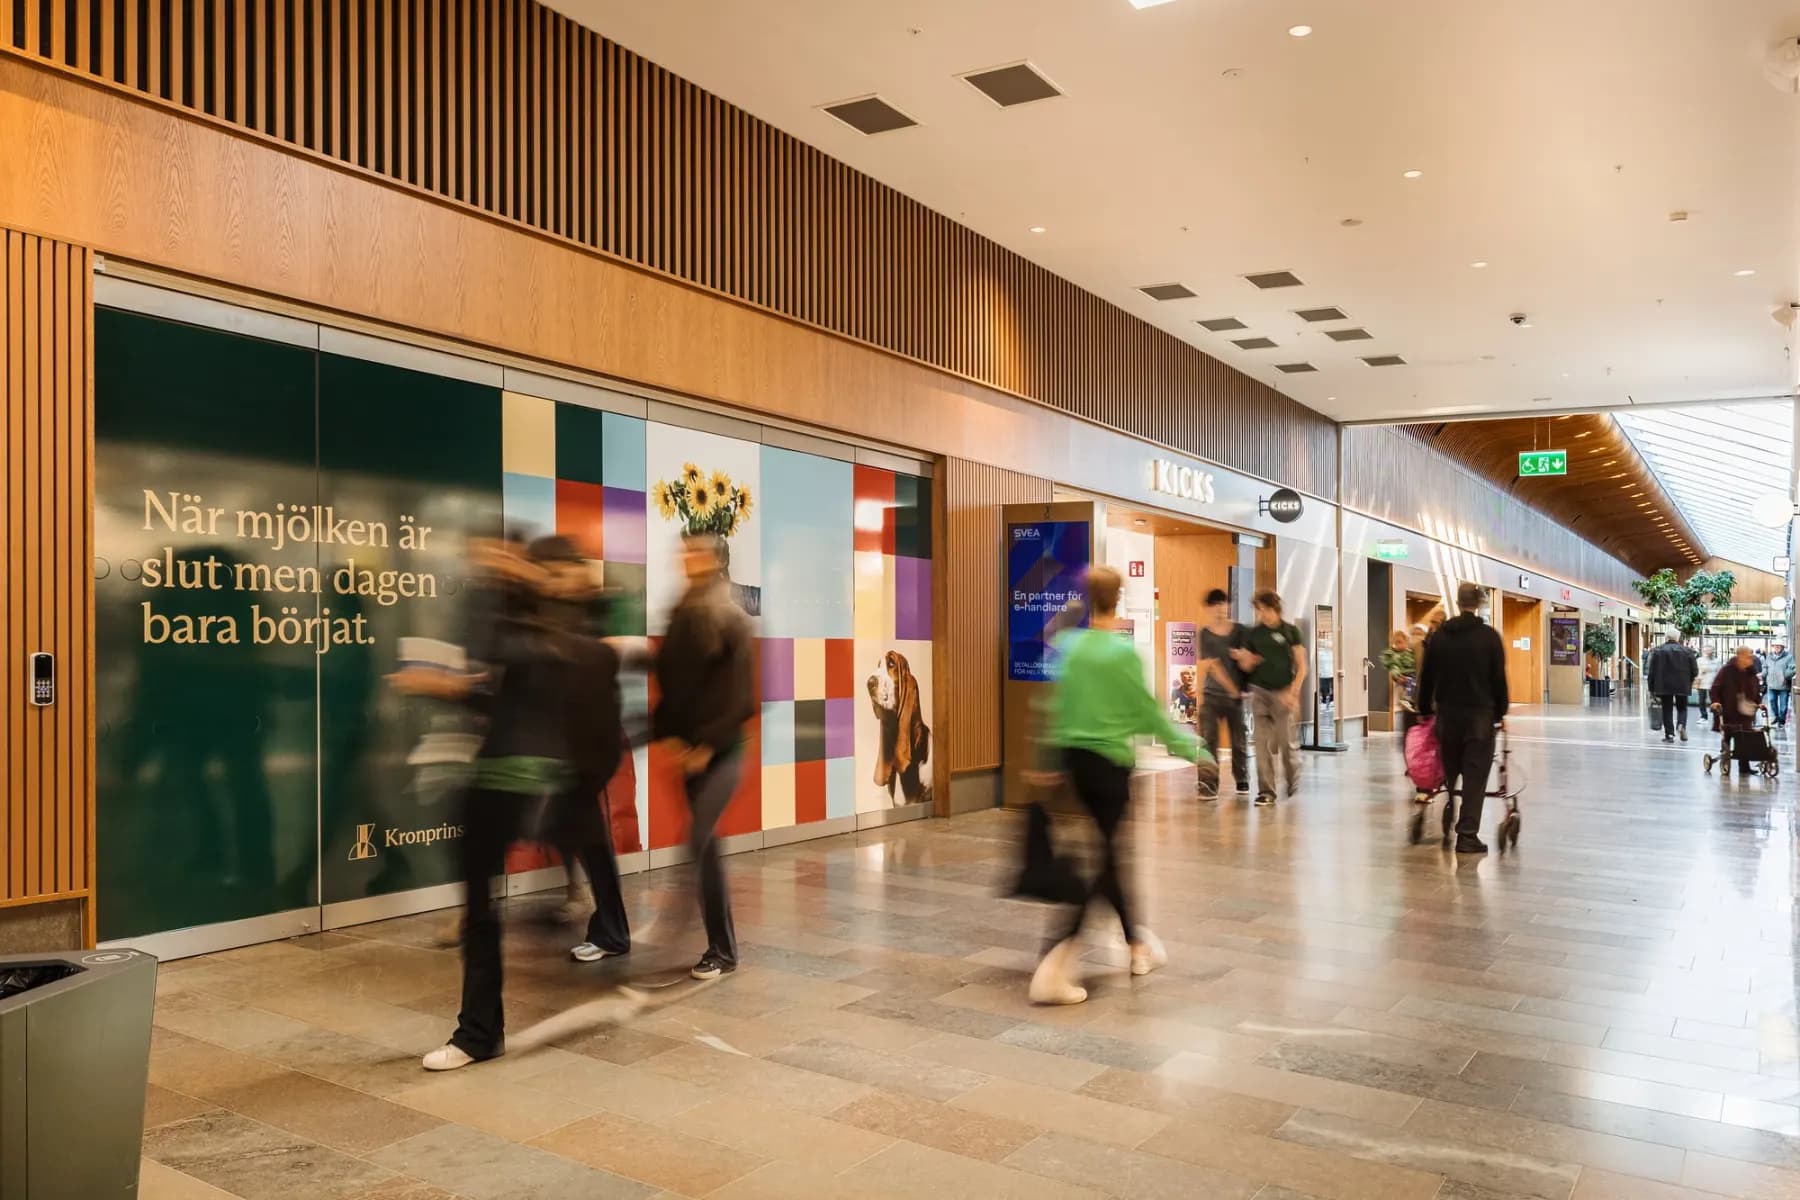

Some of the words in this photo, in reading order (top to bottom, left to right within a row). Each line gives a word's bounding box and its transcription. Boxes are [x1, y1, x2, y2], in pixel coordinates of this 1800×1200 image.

[1153, 459, 1214, 504] KICKS
[1270, 501, 1300, 512] KICKS
[143, 489, 225, 536] När
[236, 503, 390, 550] mjölken
[399, 514, 432, 550] är
[1014, 528, 1040, 538] SVEA
[141, 547, 223, 590] slut
[234, 562, 322, 593] men
[333, 559, 438, 606] dagen
[1014, 590, 1026, 601] En
[1029, 591, 1065, 604] partner
[1068, 590, 1082, 601] för
[1014, 601, 1068, 613] e-handlare
[141, 601, 240, 644] bara
[251, 604, 376, 655] börjat.
[1172, 646, 1195, 657] 30%
